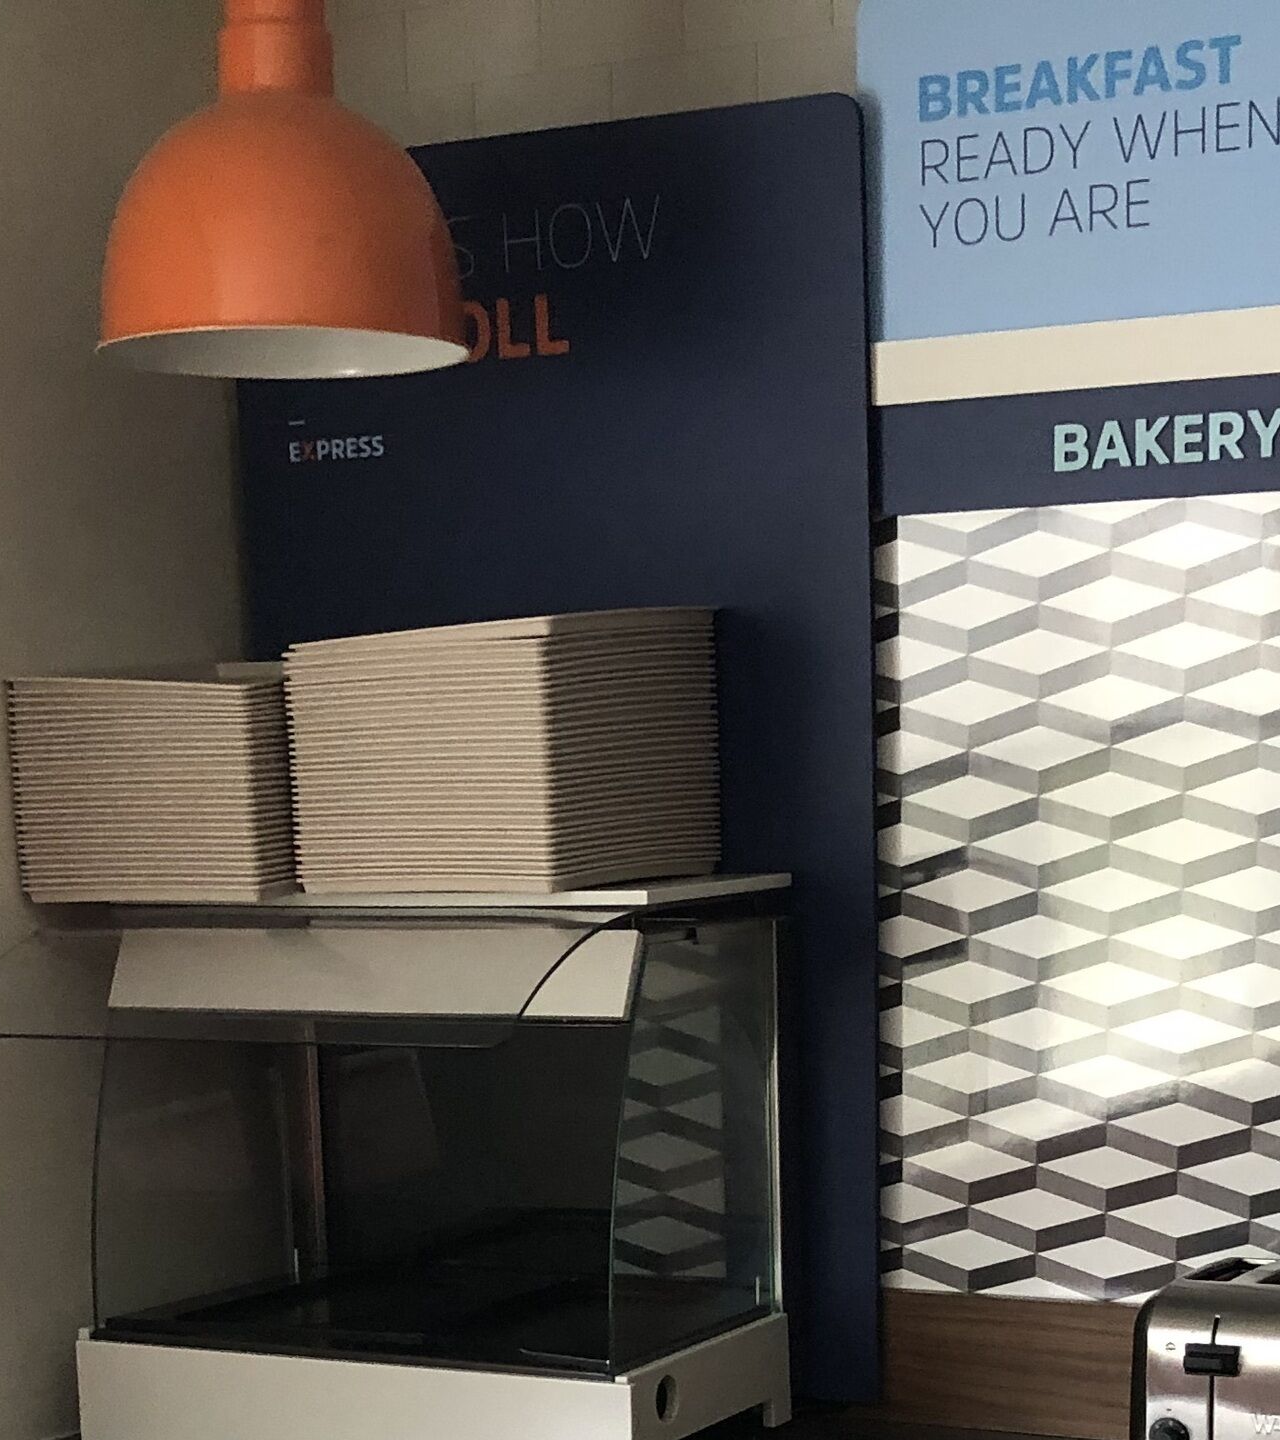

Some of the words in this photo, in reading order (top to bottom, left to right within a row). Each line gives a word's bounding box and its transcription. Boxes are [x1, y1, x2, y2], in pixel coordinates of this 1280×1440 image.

[919, 35, 1242, 122] BREAKFAST
[920, 121, 1091, 186] READY
[502, 194, 660, 273] HOW
[920, 193, 1026, 248] YOU
[1048, 179, 1151, 236] ARE
[288, 435, 385, 463] EXPRESS
